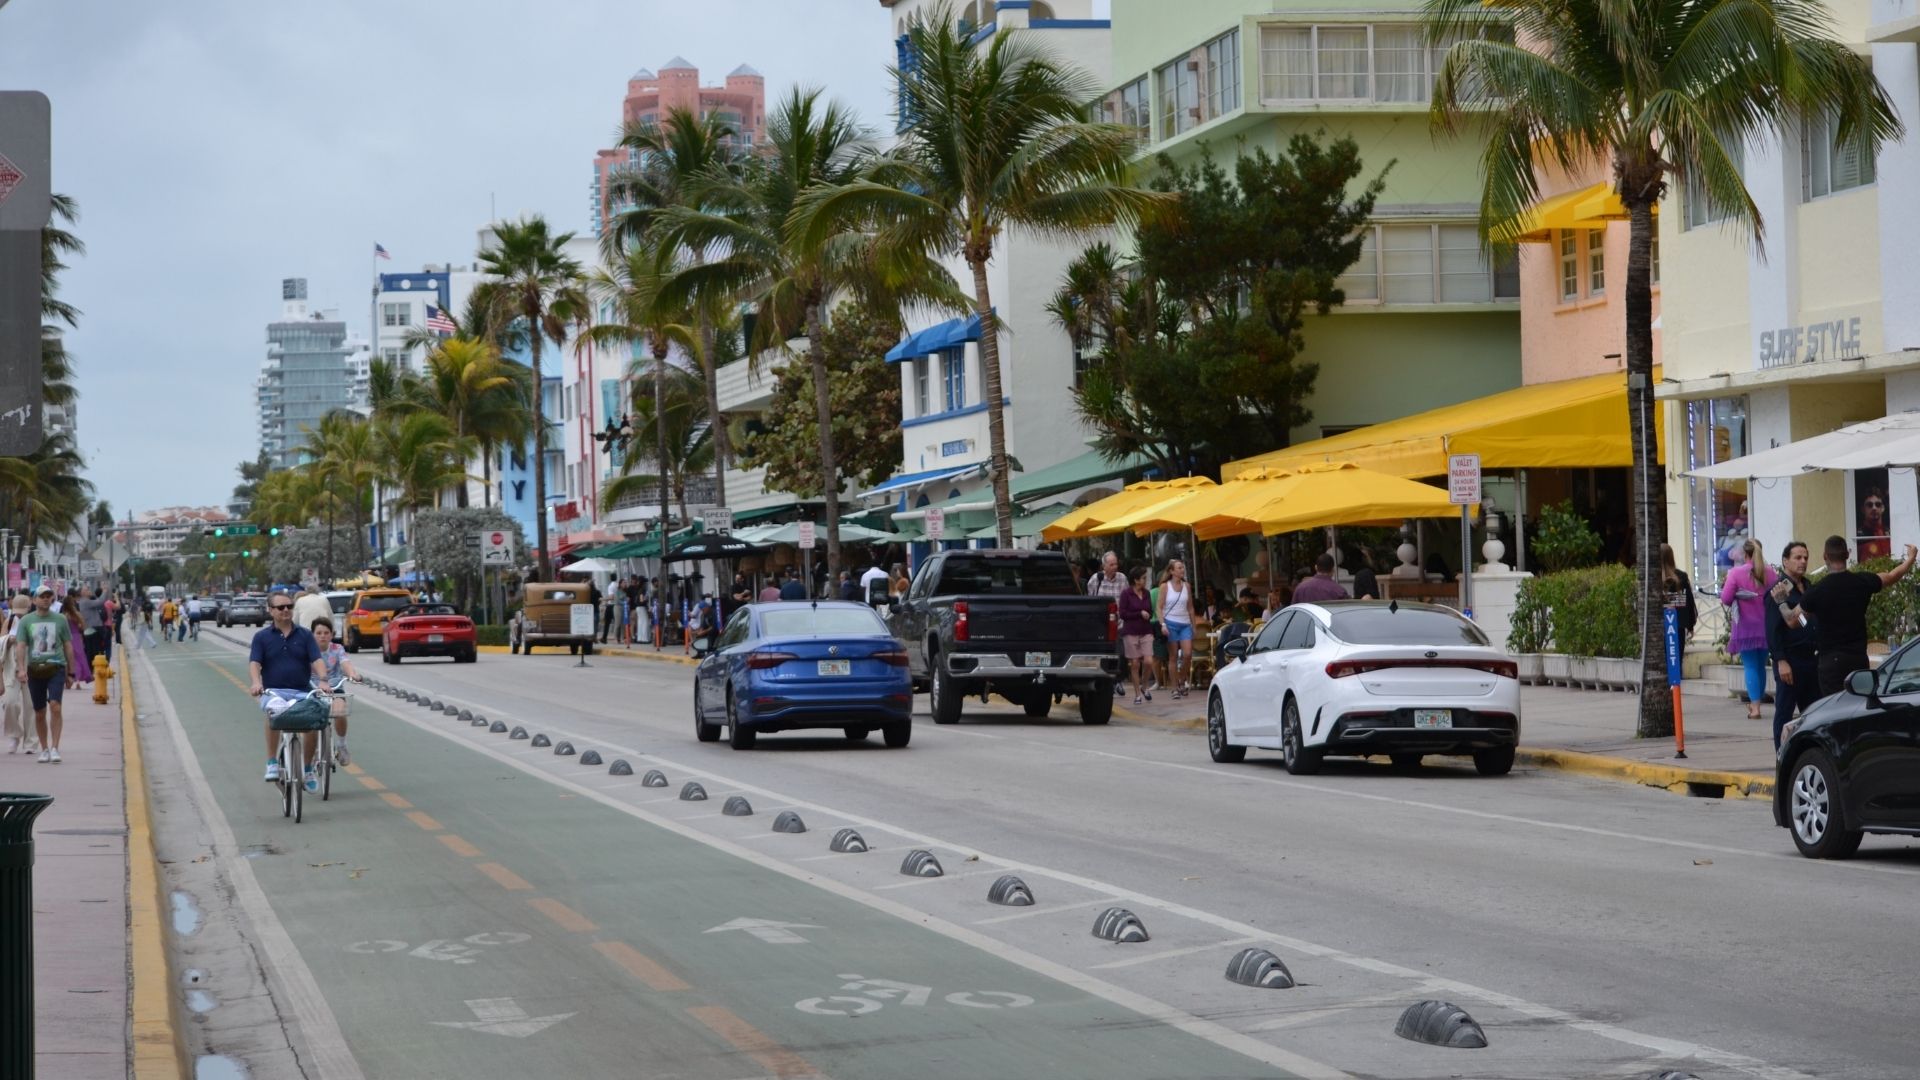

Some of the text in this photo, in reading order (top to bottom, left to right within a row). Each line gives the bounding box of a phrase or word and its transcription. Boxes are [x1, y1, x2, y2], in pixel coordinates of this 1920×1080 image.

[1760, 317, 1861, 360] SURF STYLE
[1452, 469, 1477, 478] PARKING
[1455, 458, 1473, 467] VALET
[1665, 614, 1676, 667] VALET
